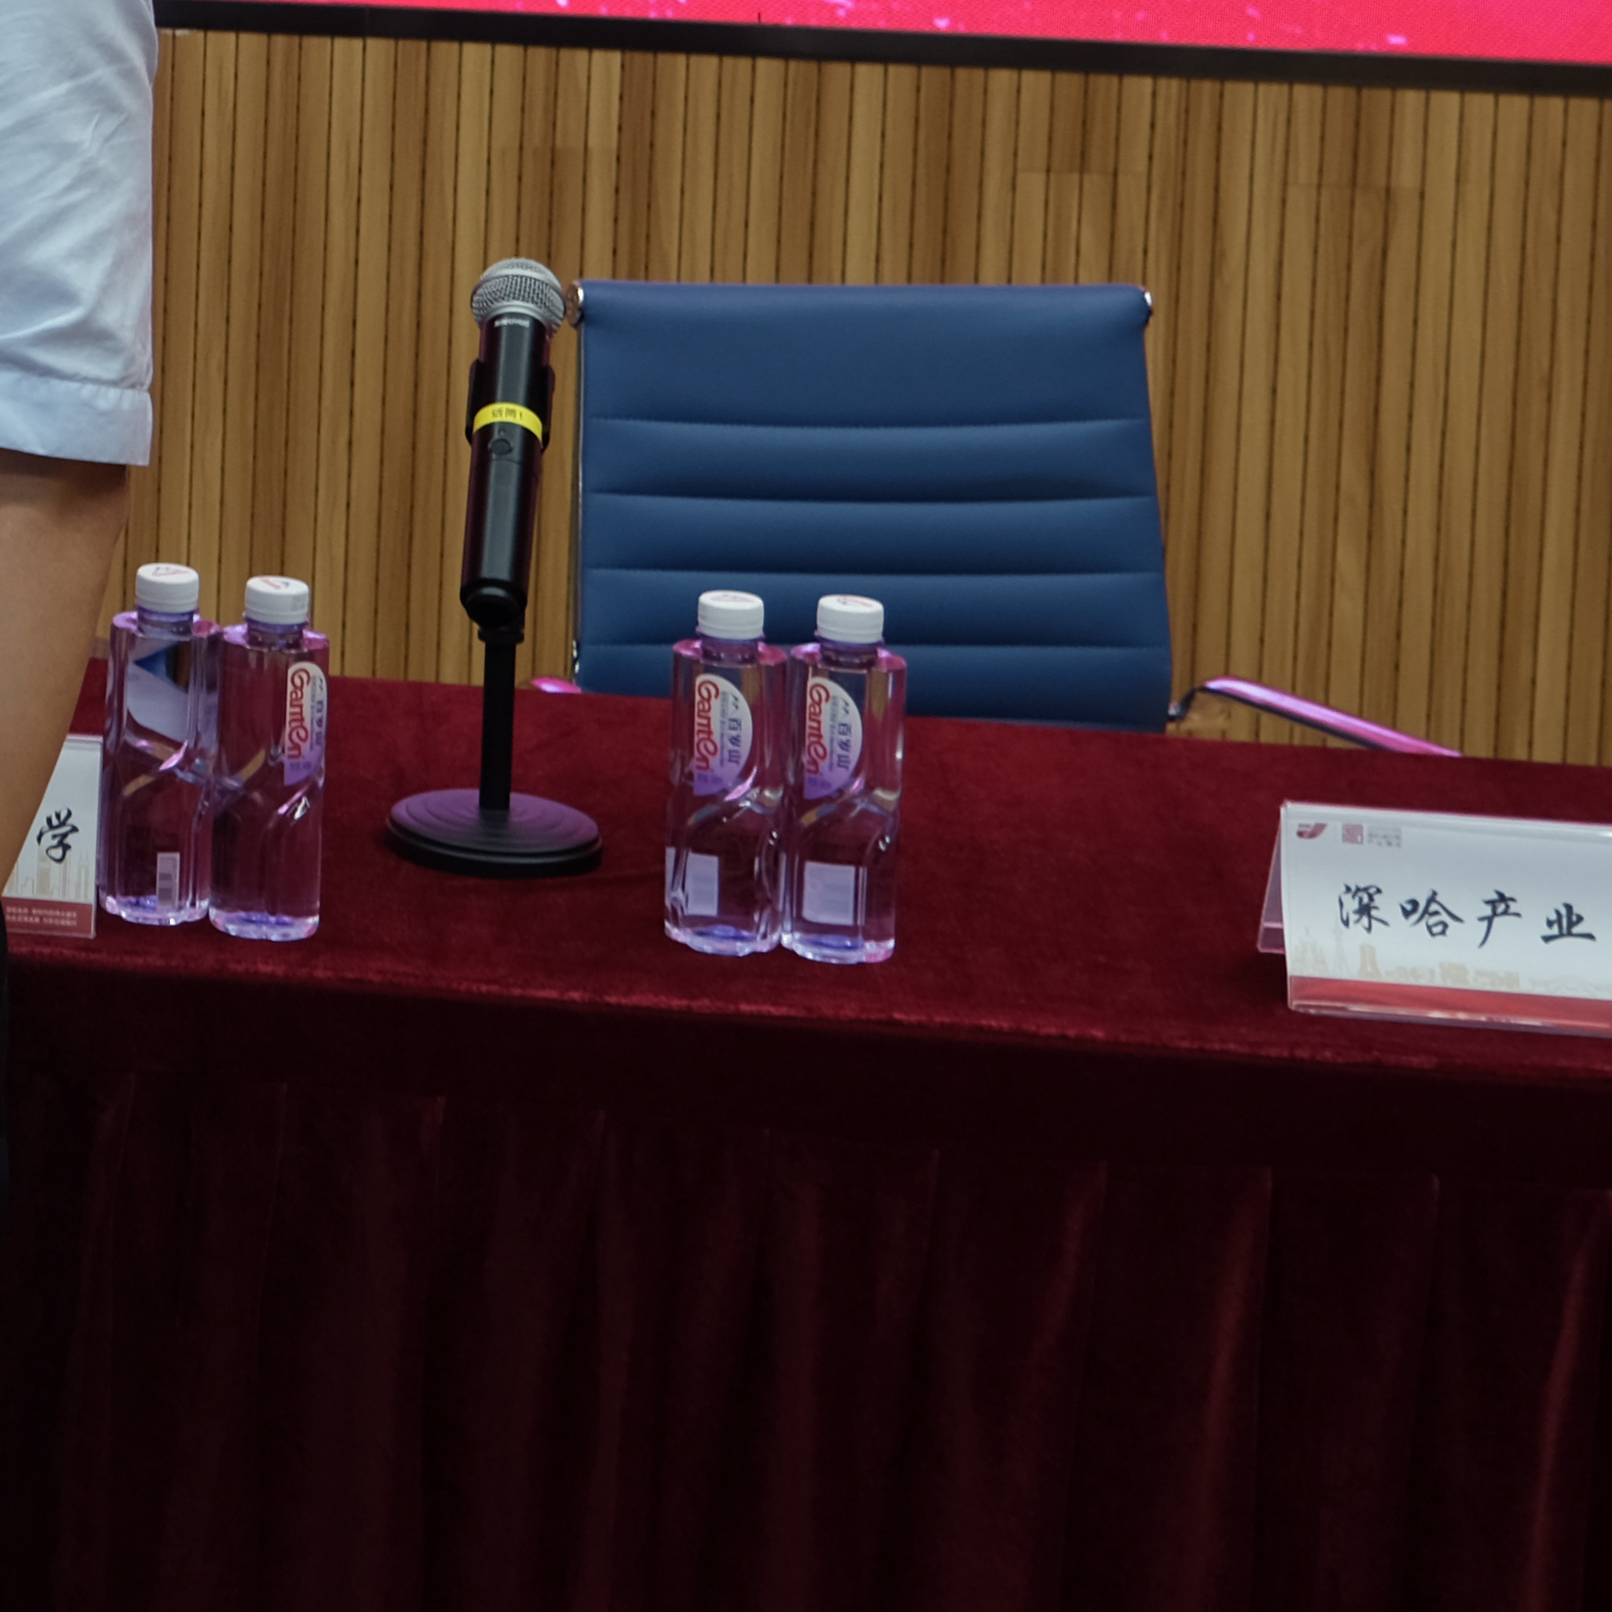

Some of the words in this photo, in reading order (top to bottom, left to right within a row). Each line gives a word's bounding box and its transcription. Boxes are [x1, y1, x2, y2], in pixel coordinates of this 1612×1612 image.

[287, 668, 311, 761] Ganten
[695, 679, 720, 772] Ganten
[727, 718, 742, 766] 百岁山
[805, 681, 830, 776] Ganten
[837, 723, 851, 770] 百岁山
[35, 806, 80, 864] 学
[1337, 882, 1597, 949] 深哈产业
